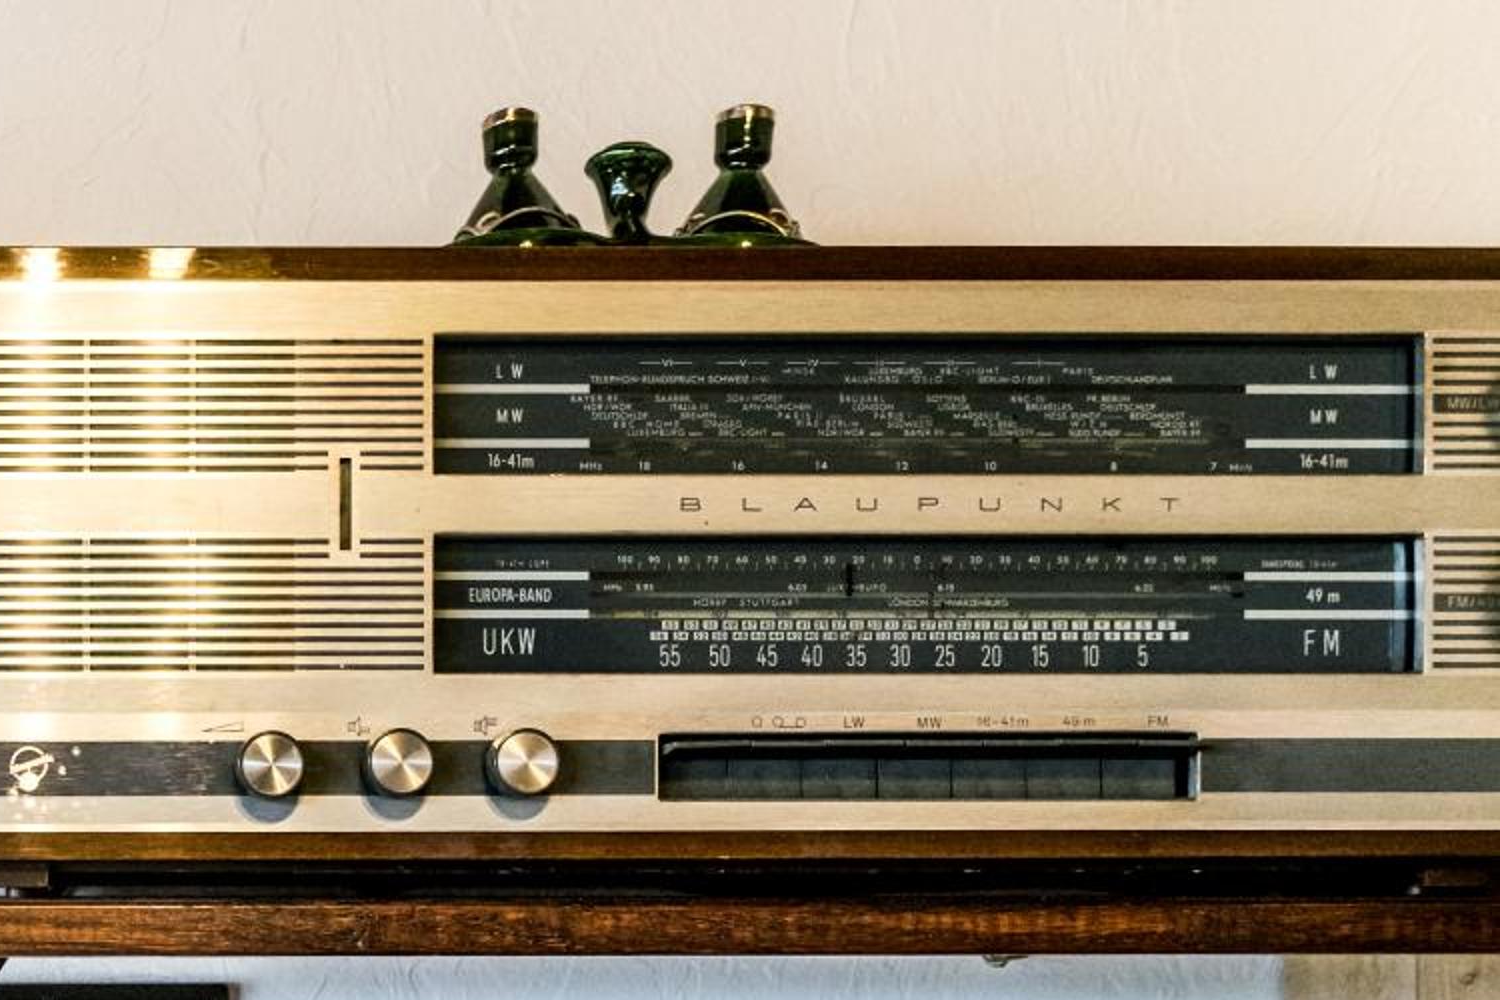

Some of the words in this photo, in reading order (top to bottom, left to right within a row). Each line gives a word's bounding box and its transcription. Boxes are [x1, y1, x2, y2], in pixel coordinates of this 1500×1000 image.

[496, 407, 524, 423] MW
[1309, 409, 1338, 424] MW
[487, 453, 535, 469] 16-41m
[1300, 453, 1349, 469] 16-41m
[680, 497, 1179, 512] BLAUPUNKT
[468, 586, 553, 603] EUROPA-BAND
[1305, 587, 1323, 603] 49
[1327, 592, 1341, 603] m
[482, 627, 536, 655] UKW
[1303, 628, 1340, 656] FM
[659, 644, 681, 667] 55
[709, 644, 731, 667] 50
[756, 644, 778, 667] 45
[801, 644, 823, 667] 40
[846, 644, 867, 667] 35
[889, 644, 911, 667] 30
[935, 644, 955, 667] 25
[981, 644, 1002, 667] 20
[1032, 644, 1049, 667] 15
[1083, 644, 1099, 667] 10
[1137, 644, 1149, 667] 5
[843, 716, 865, 728] LW
[916, 716, 943, 729] MW
